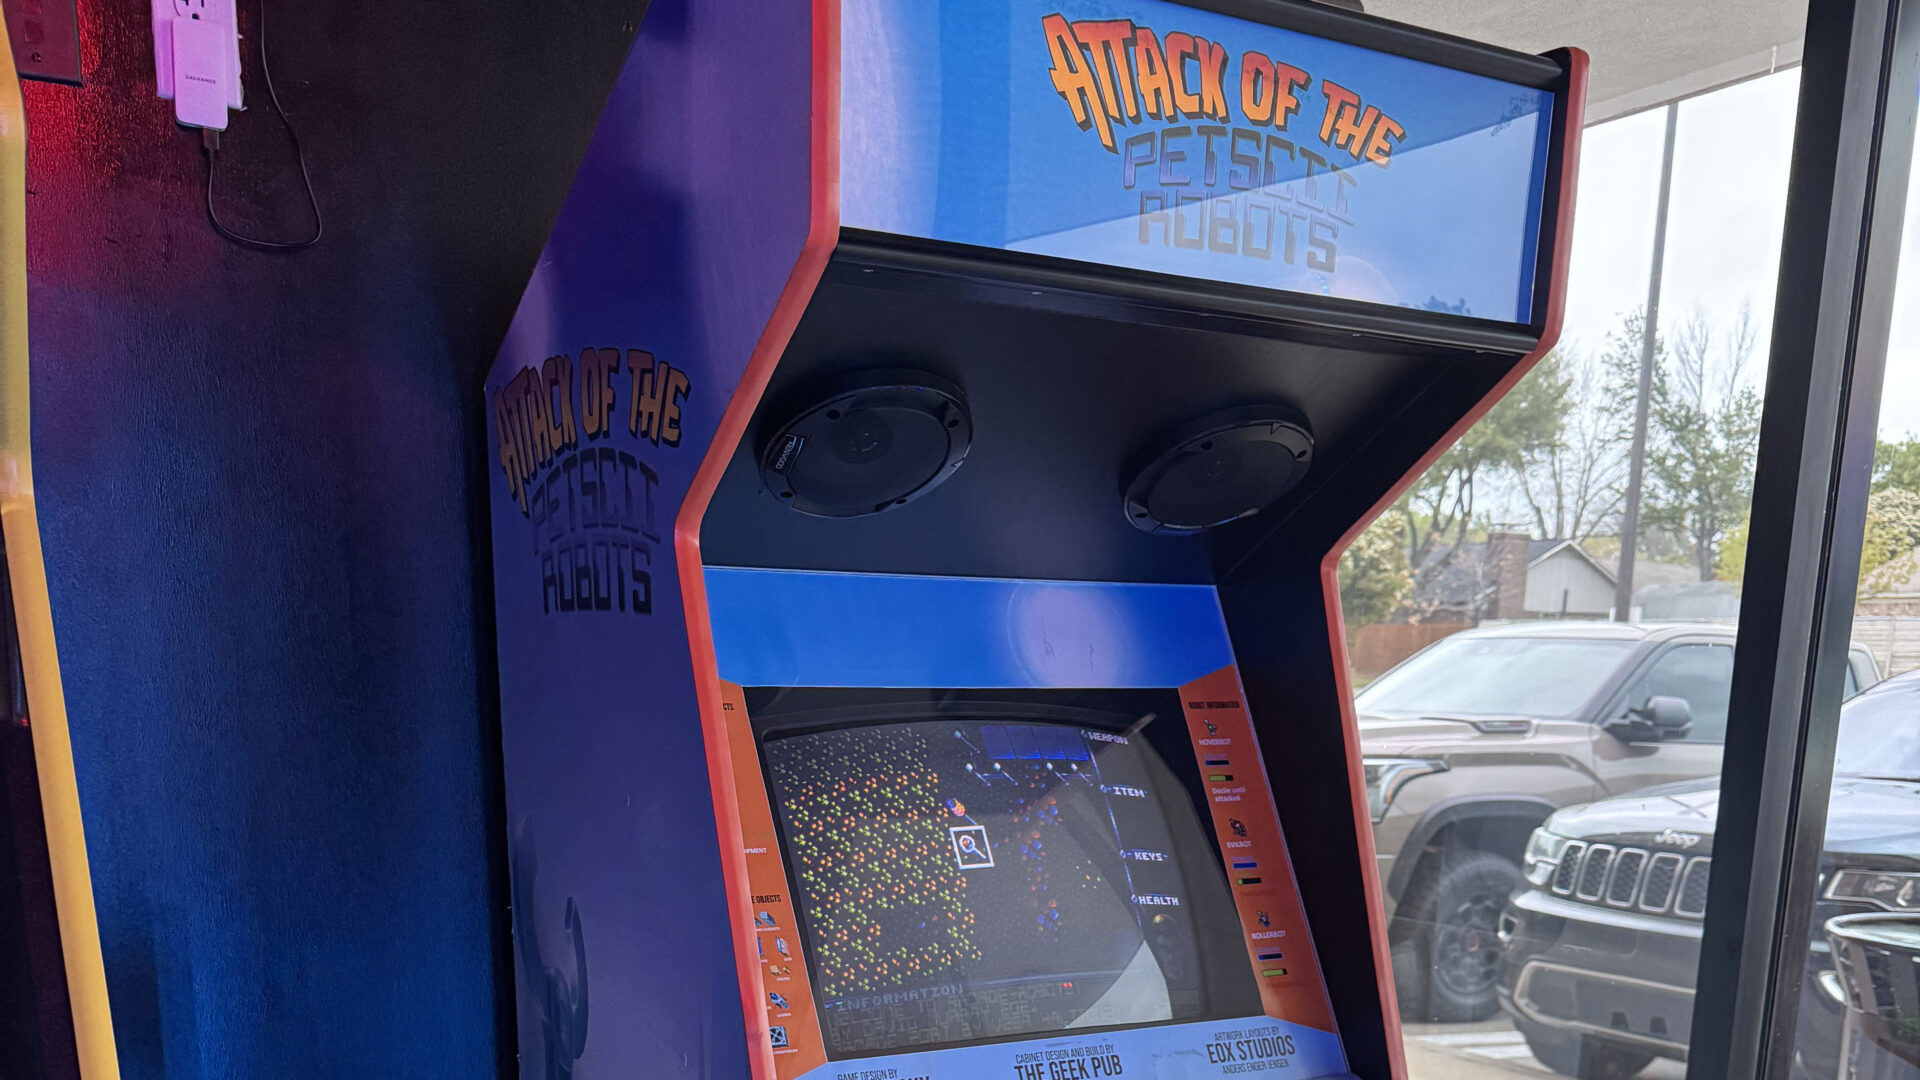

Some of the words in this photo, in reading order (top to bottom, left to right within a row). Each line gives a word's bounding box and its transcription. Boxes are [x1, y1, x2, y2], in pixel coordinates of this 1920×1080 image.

[1041, 12, 1231, 155] ATTACK
[1240, 50, 1312, 132] OF
[1318, 79, 1407, 169] THE
[1123, 125, 1357, 226] PETSCII
[1138, 190, 1338, 274] ROBOTS
[493, 353, 578, 520] ATTACK
[579, 346, 620, 441] OF
[626, 348, 691, 448] THE
[531, 446, 661, 557] PETSCII
[540, 536, 652, 616] ROBOTS
[1088, 731, 1128, 745] WEAPON
[1113, 786, 1145, 798] ITEM
[1226, 841, 1251, 849] EVILBOT
[1655, 828, 1700, 849] Jeep
[1134, 851, 1163, 861] KEYS
[756, 894, 781, 904] OBJECTS
[1138, 895, 1179, 906] HEALTH
[1251, 930, 1286, 940] ROLLERBOT
[836, 983, 964, 1013] INFORMATION
[1214, 1030, 1243, 1042] ARTWORK
[1244, 1027, 1271, 1038] LAYOUTS
[1271, 1026, 1279, 1036] BY
[1015, 1051, 1044, 1064] CABINET
[1045, 1048, 1070, 1061] DESIGN
[1071, 1047, 1084, 1058] AND
[1085, 1045, 1104, 1056] BUILD
[1105, 1044, 1114, 1054] BY
[1206, 1042, 1236, 1064] EOX
[1236, 1035, 1296, 1061] STUDIOS
[837, 1072, 859, 1080] GAME
[860, 1070, 887, 1080] DESIGN
[888, 1068, 898, 1079] BY
[1014, 1062, 1046, 1080] THE
[1048, 1058, 1090, 1080] GEEK
[1091, 1054, 1123, 1078] PUB
[1222, 1063, 1247, 1074] ANDERS
[1268, 1059, 1289, 1070] JENSEN
